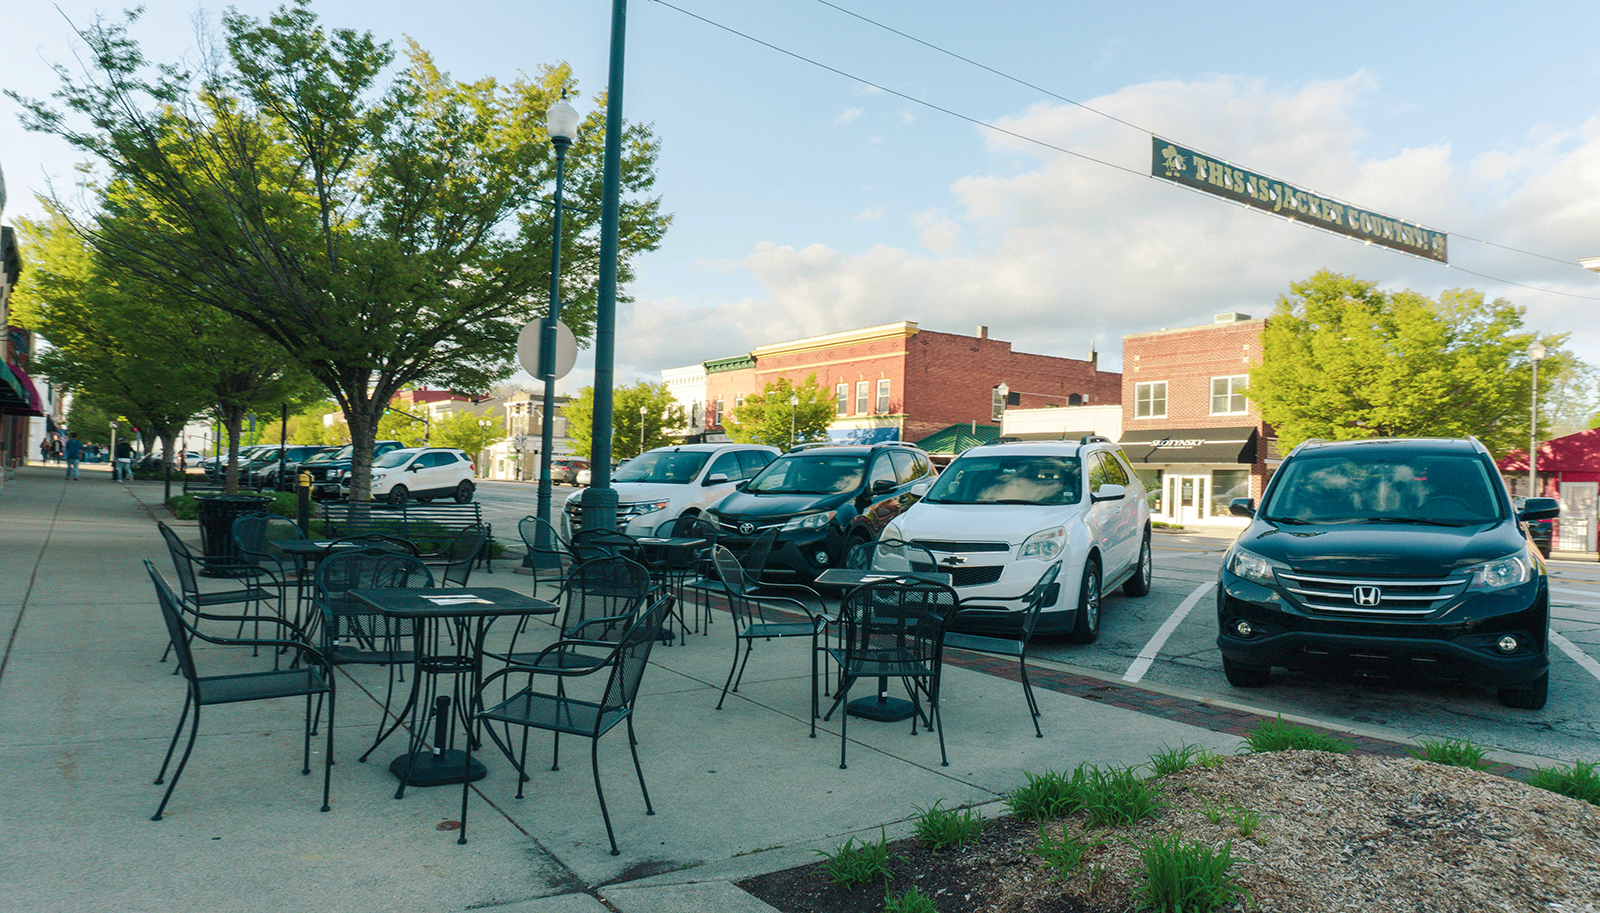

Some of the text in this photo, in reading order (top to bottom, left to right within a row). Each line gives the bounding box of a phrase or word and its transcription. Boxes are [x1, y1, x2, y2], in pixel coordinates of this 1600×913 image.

[1193, 155, 1429, 251] THIS IS JACKET COUNTRY!
